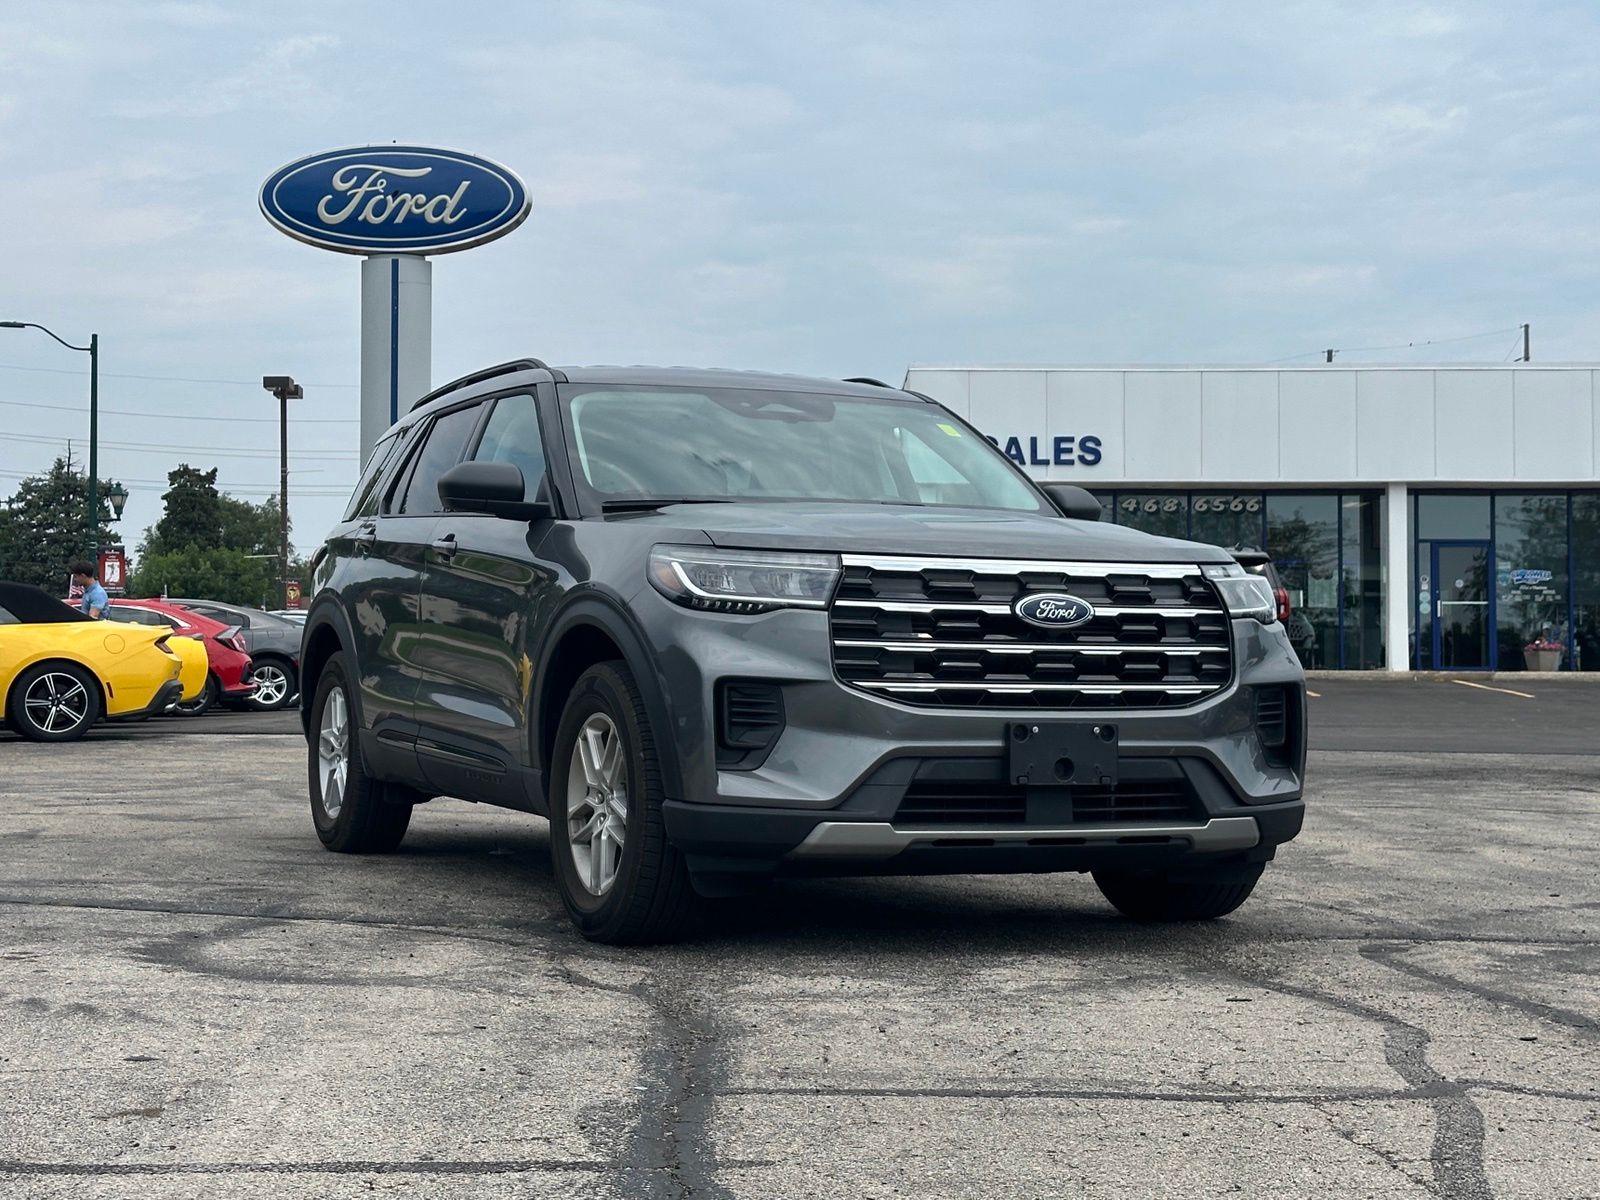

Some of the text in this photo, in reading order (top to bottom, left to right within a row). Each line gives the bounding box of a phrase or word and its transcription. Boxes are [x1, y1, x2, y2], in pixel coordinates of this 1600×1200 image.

[317, 164, 471, 225] Ford
[985, 435, 1102, 466] ALES
[1036, 599, 1077, 620] Ford
